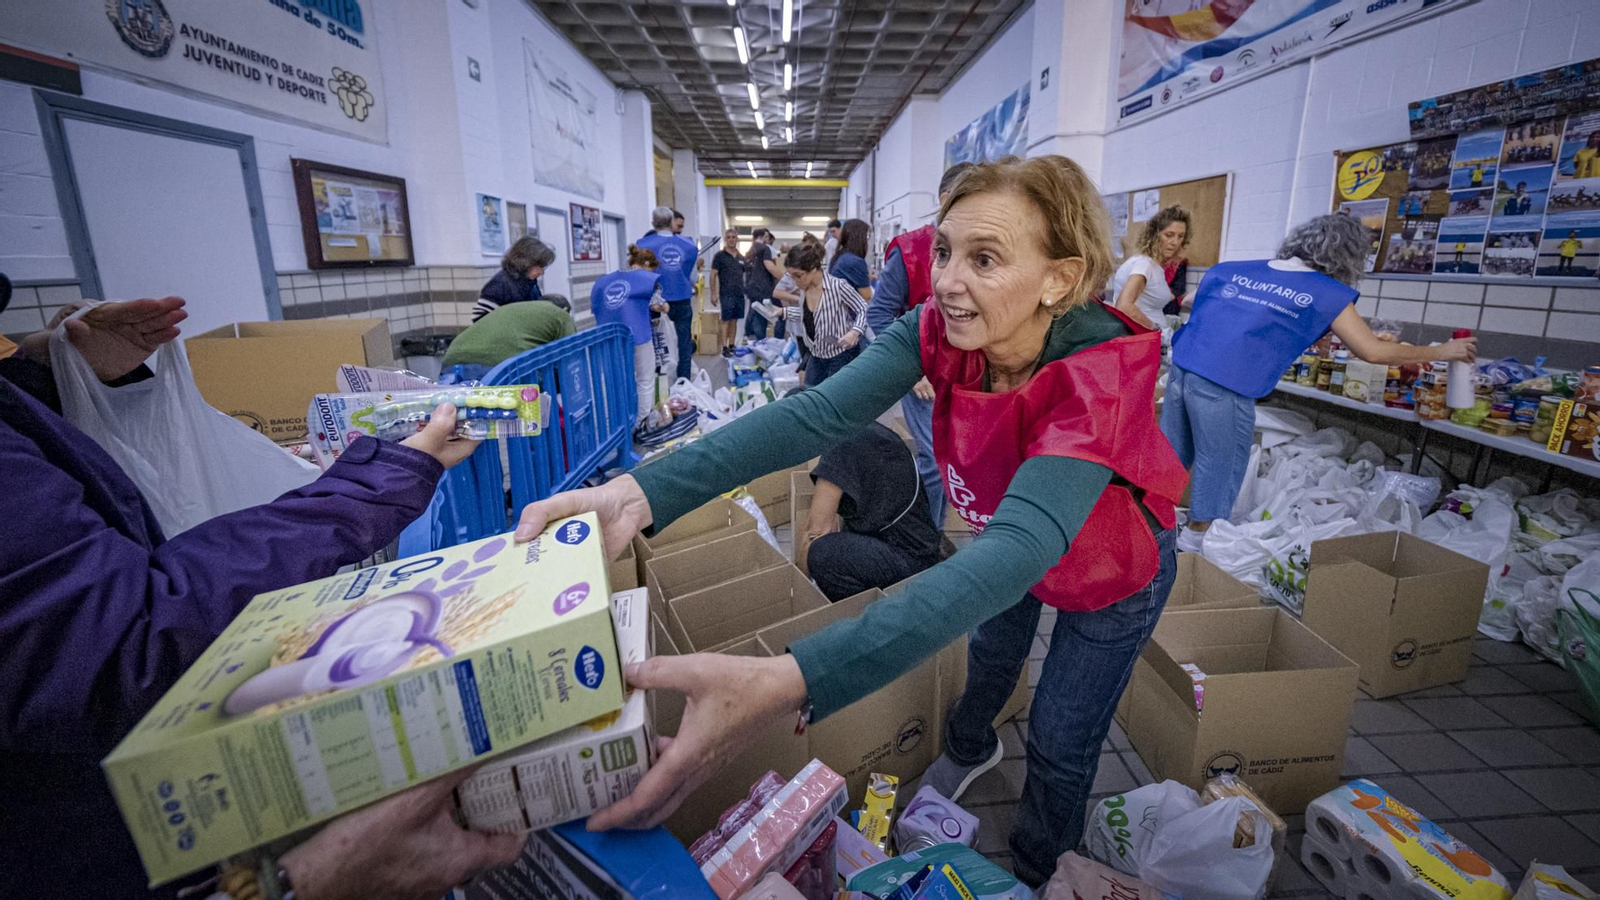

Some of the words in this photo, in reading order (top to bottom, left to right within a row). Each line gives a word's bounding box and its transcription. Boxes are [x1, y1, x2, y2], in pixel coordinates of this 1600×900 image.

[303, 9, 322, 29] de
[327, 21, 365, 50] 50m.
[179, 23, 279, 70] AYUNTAMIENTO
[281, 62, 294, 77] DE
[182, 43, 262, 82] JUVENTUD
[265, 73, 273, 87] Y
[277, 77, 327, 105] DEPORTE
[1231, 274, 1313, 308] VOLUNTARI@
[1237, 294, 1260, 304] BANCOS
[1267, 302, 1300, 319] ALIMENTOS
[269, 417, 303, 426] BANCO
[1548, 433, 1562, 452] PACK
[1555, 403, 1572, 433] AHORRO
[566, 522, 581, 543] Hero
[550, 658, 573, 704] Cereales
[581, 651, 599, 686] Hero
[1248, 768, 1260, 776] DE
[1249, 758, 1278, 768] BANCO
[1278, 757, 1290, 766] DE
[1290, 753, 1336, 765] ALIMENTOS
[948, 870, 961, 886] MAXI
